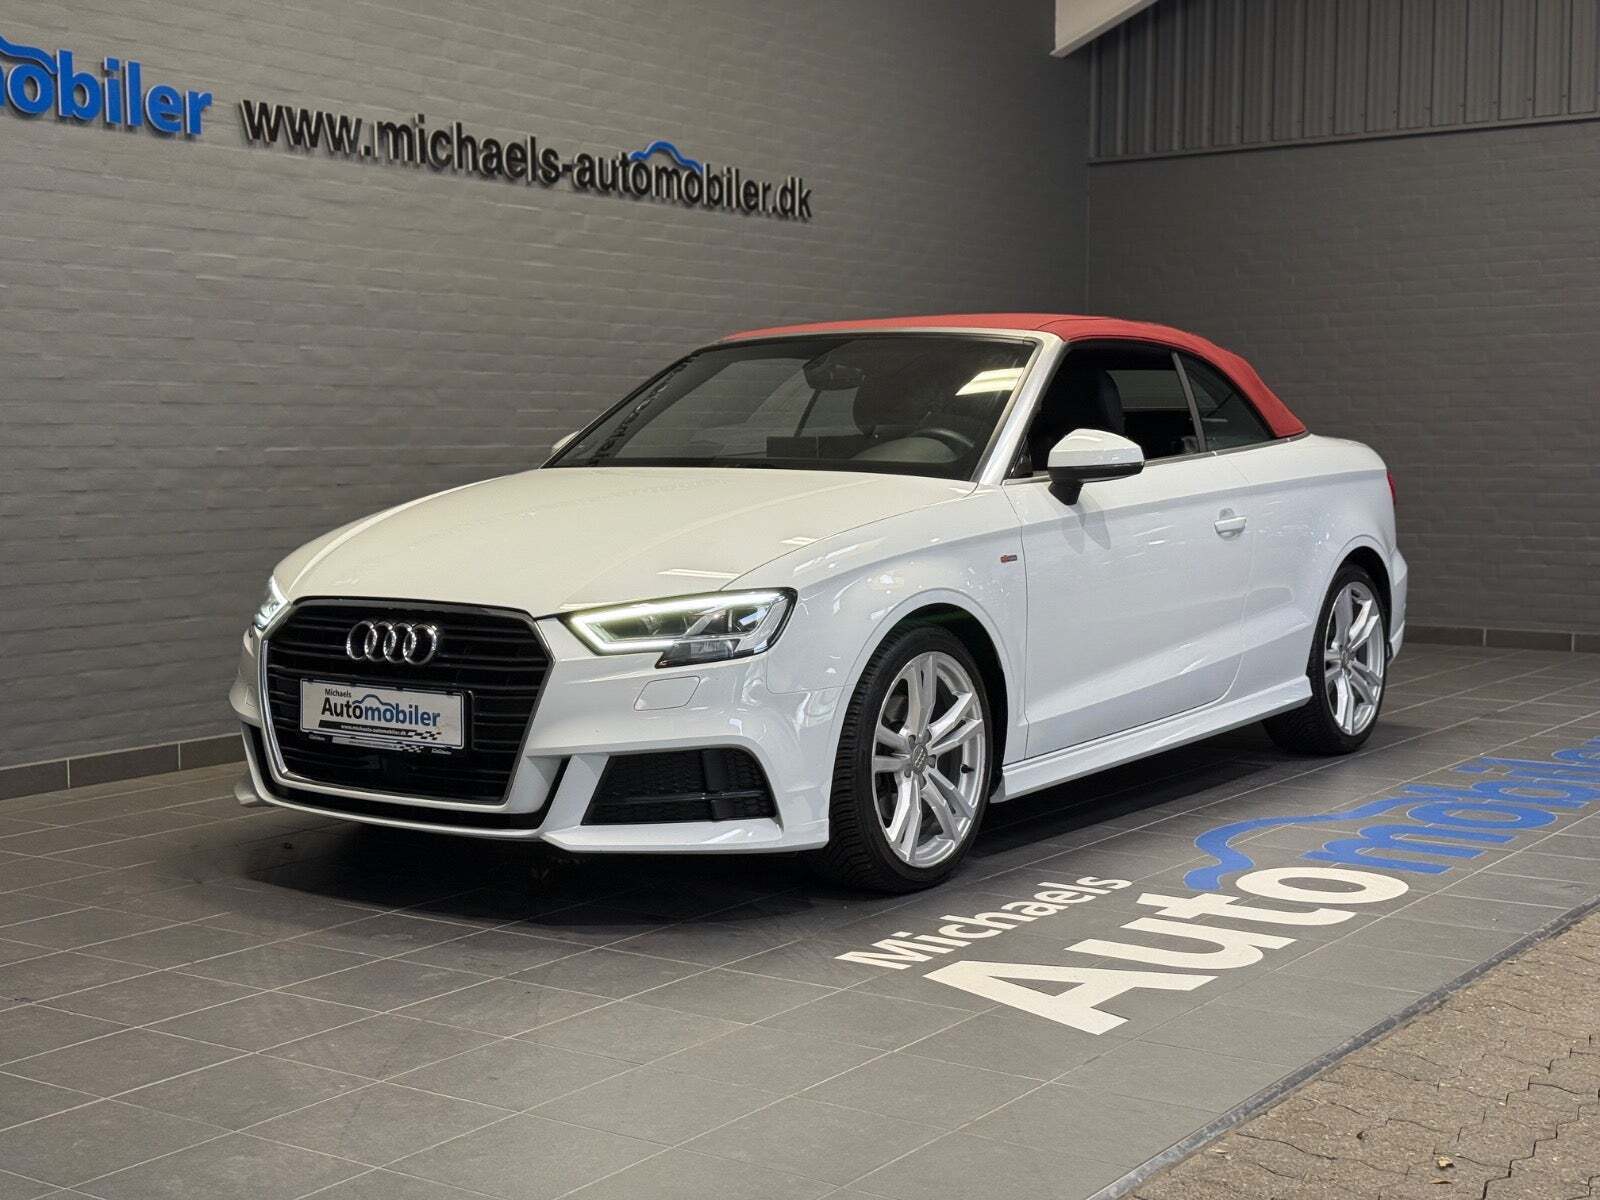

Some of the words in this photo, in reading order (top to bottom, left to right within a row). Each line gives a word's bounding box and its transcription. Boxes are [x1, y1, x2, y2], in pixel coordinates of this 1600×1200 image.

[0, 48, 213, 135] obiler
[239, 99, 812, 219] www.michaels-automobiler.dk
[321, 697, 441, 727] Automobiler
[324, 688, 352, 698] Michaels
[834, 876, 1132, 970] Michaels
